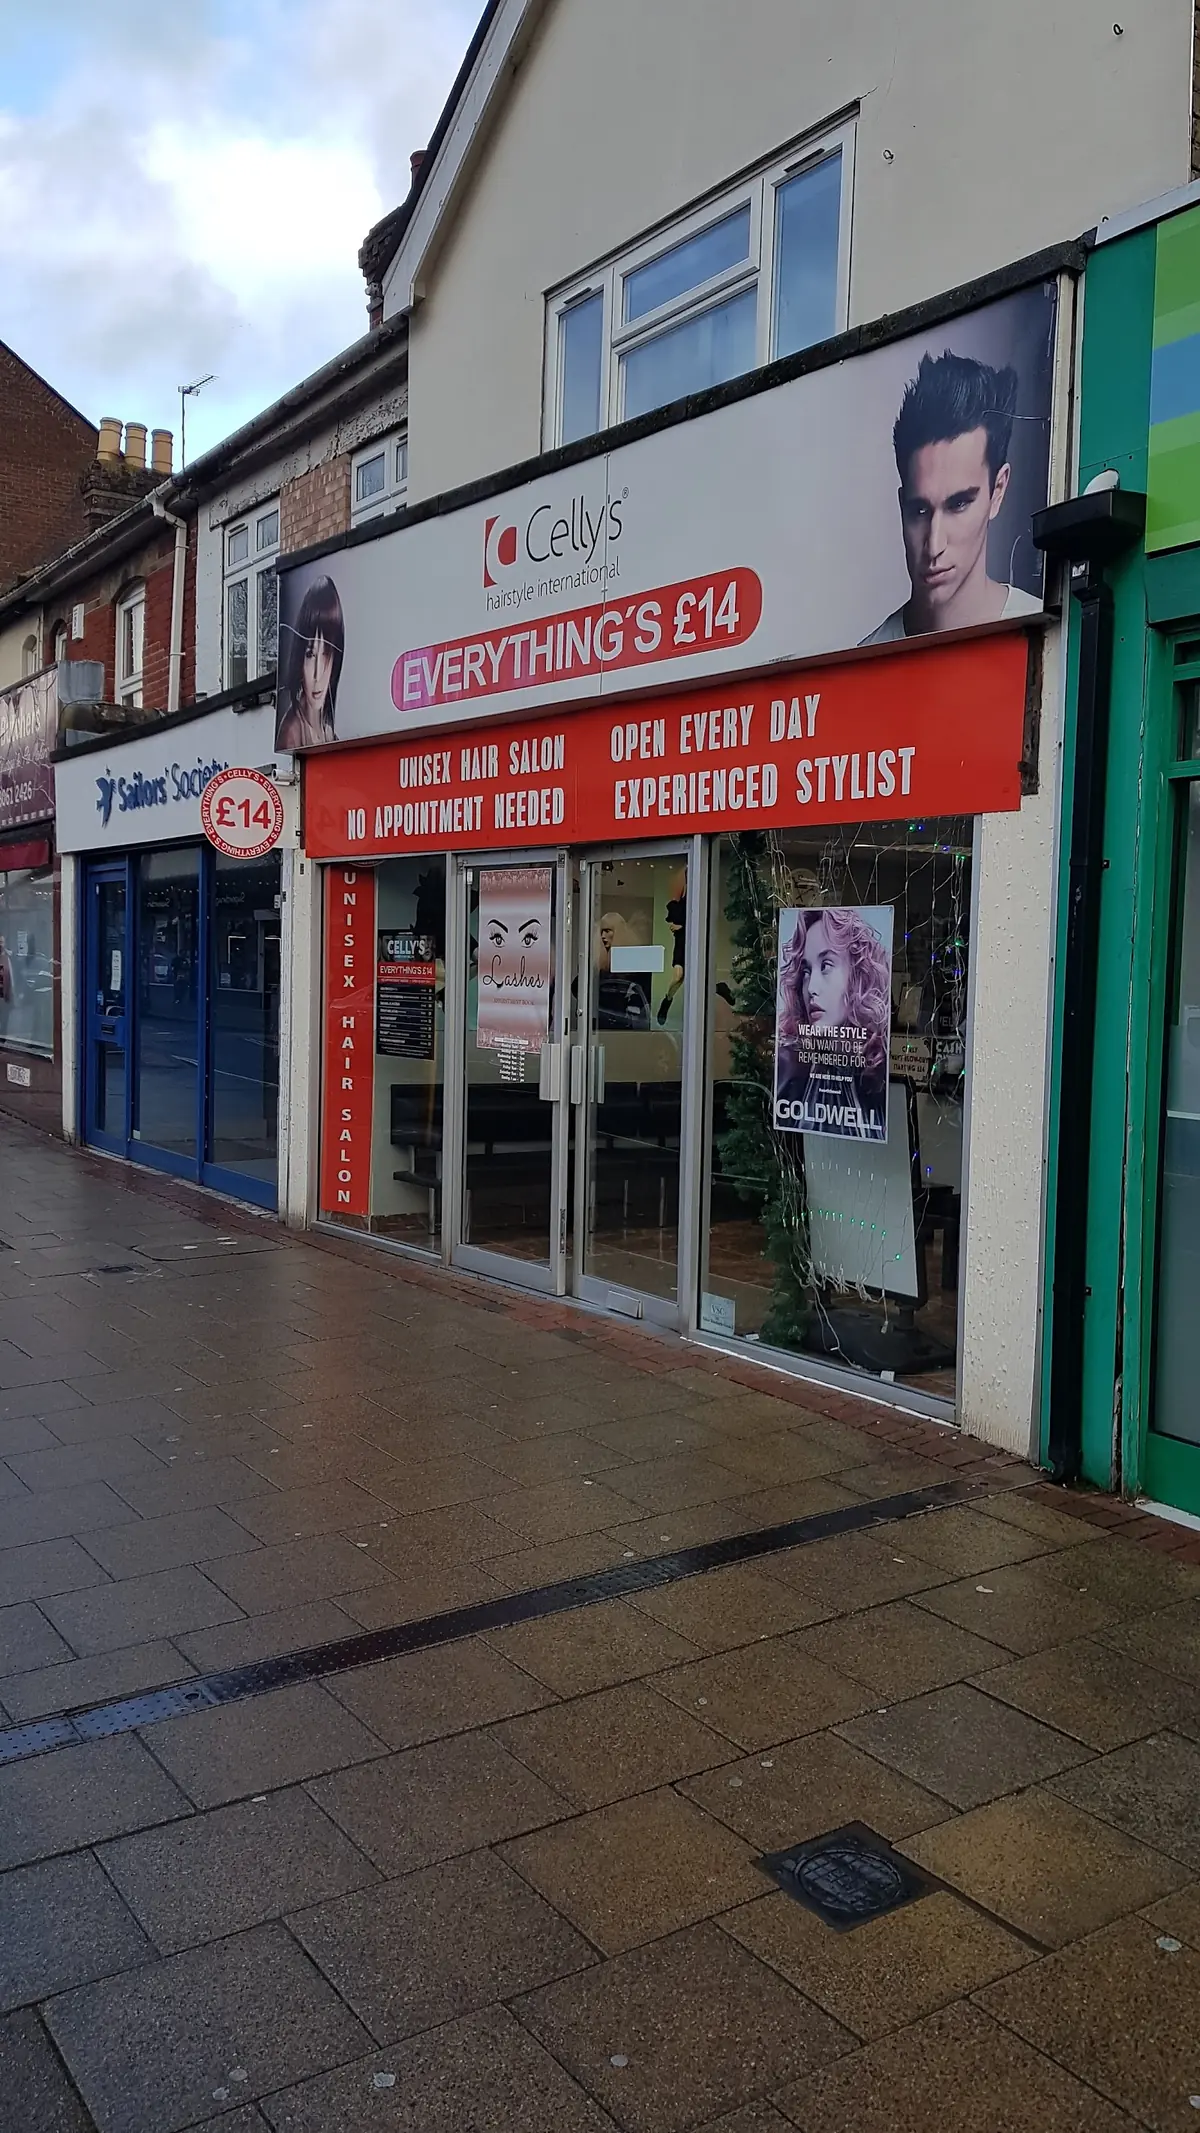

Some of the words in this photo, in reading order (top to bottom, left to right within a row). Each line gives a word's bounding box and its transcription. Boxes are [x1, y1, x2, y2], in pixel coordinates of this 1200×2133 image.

[525, 494, 622, 565] Celly's
[486, 581, 534, 611] hairstyle
[537, 555, 621, 598] international
[402, 600, 662, 703] EVERYTHING'S
[672, 581, 740, 646] £14
[610, 718, 665, 763] OPEN
[680, 704, 755, 754] EVERY
[770, 693, 821, 743] DAY
[227, 769, 260, 781] CELLY'S
[400, 751, 452, 789] UNISEX
[460, 744, 499, 782] HAIR
[509, 734, 565, 776] SALON
[614, 763, 778, 820] EXPERIENCED
[796, 746, 916, 804] STYLIST
[202, 775, 224, 836] EVERYTHING'S
[215, 796, 272, 829] £14
[263, 780, 283, 840] EVERYTHING'S
[347, 808, 366, 840] NO
[374, 795, 484, 839] APPOINTMENT
[494, 787, 565, 829] NEEDED
[214, 838, 271, 857] EVERYTHING'S
[343, 872, 356, 987] UNISEX
[387, 939, 426, 955] CELLY'S
[380, 965, 422, 975] EVERYTHING'S
[482, 954, 545, 989] Lashes
[341, 1016, 355, 1090] HAIR
[798, 1024, 821, 1037] WEAR
[822, 1025, 839, 1038] THE
[840, 1026, 868, 1040] STYLE
[801, 1038, 816, 1050] YOU
[816, 1038, 839, 1051] WANT
[841, 1040, 851, 1053] TO
[853, 1041, 863, 1054] BE
[798, 1051, 848, 1067] REMEMBERED
[850, 1055, 866, 1068] FOR
[775, 1098, 883, 1131] GOLDWELL
[337, 1108, 353, 1203] SALON
